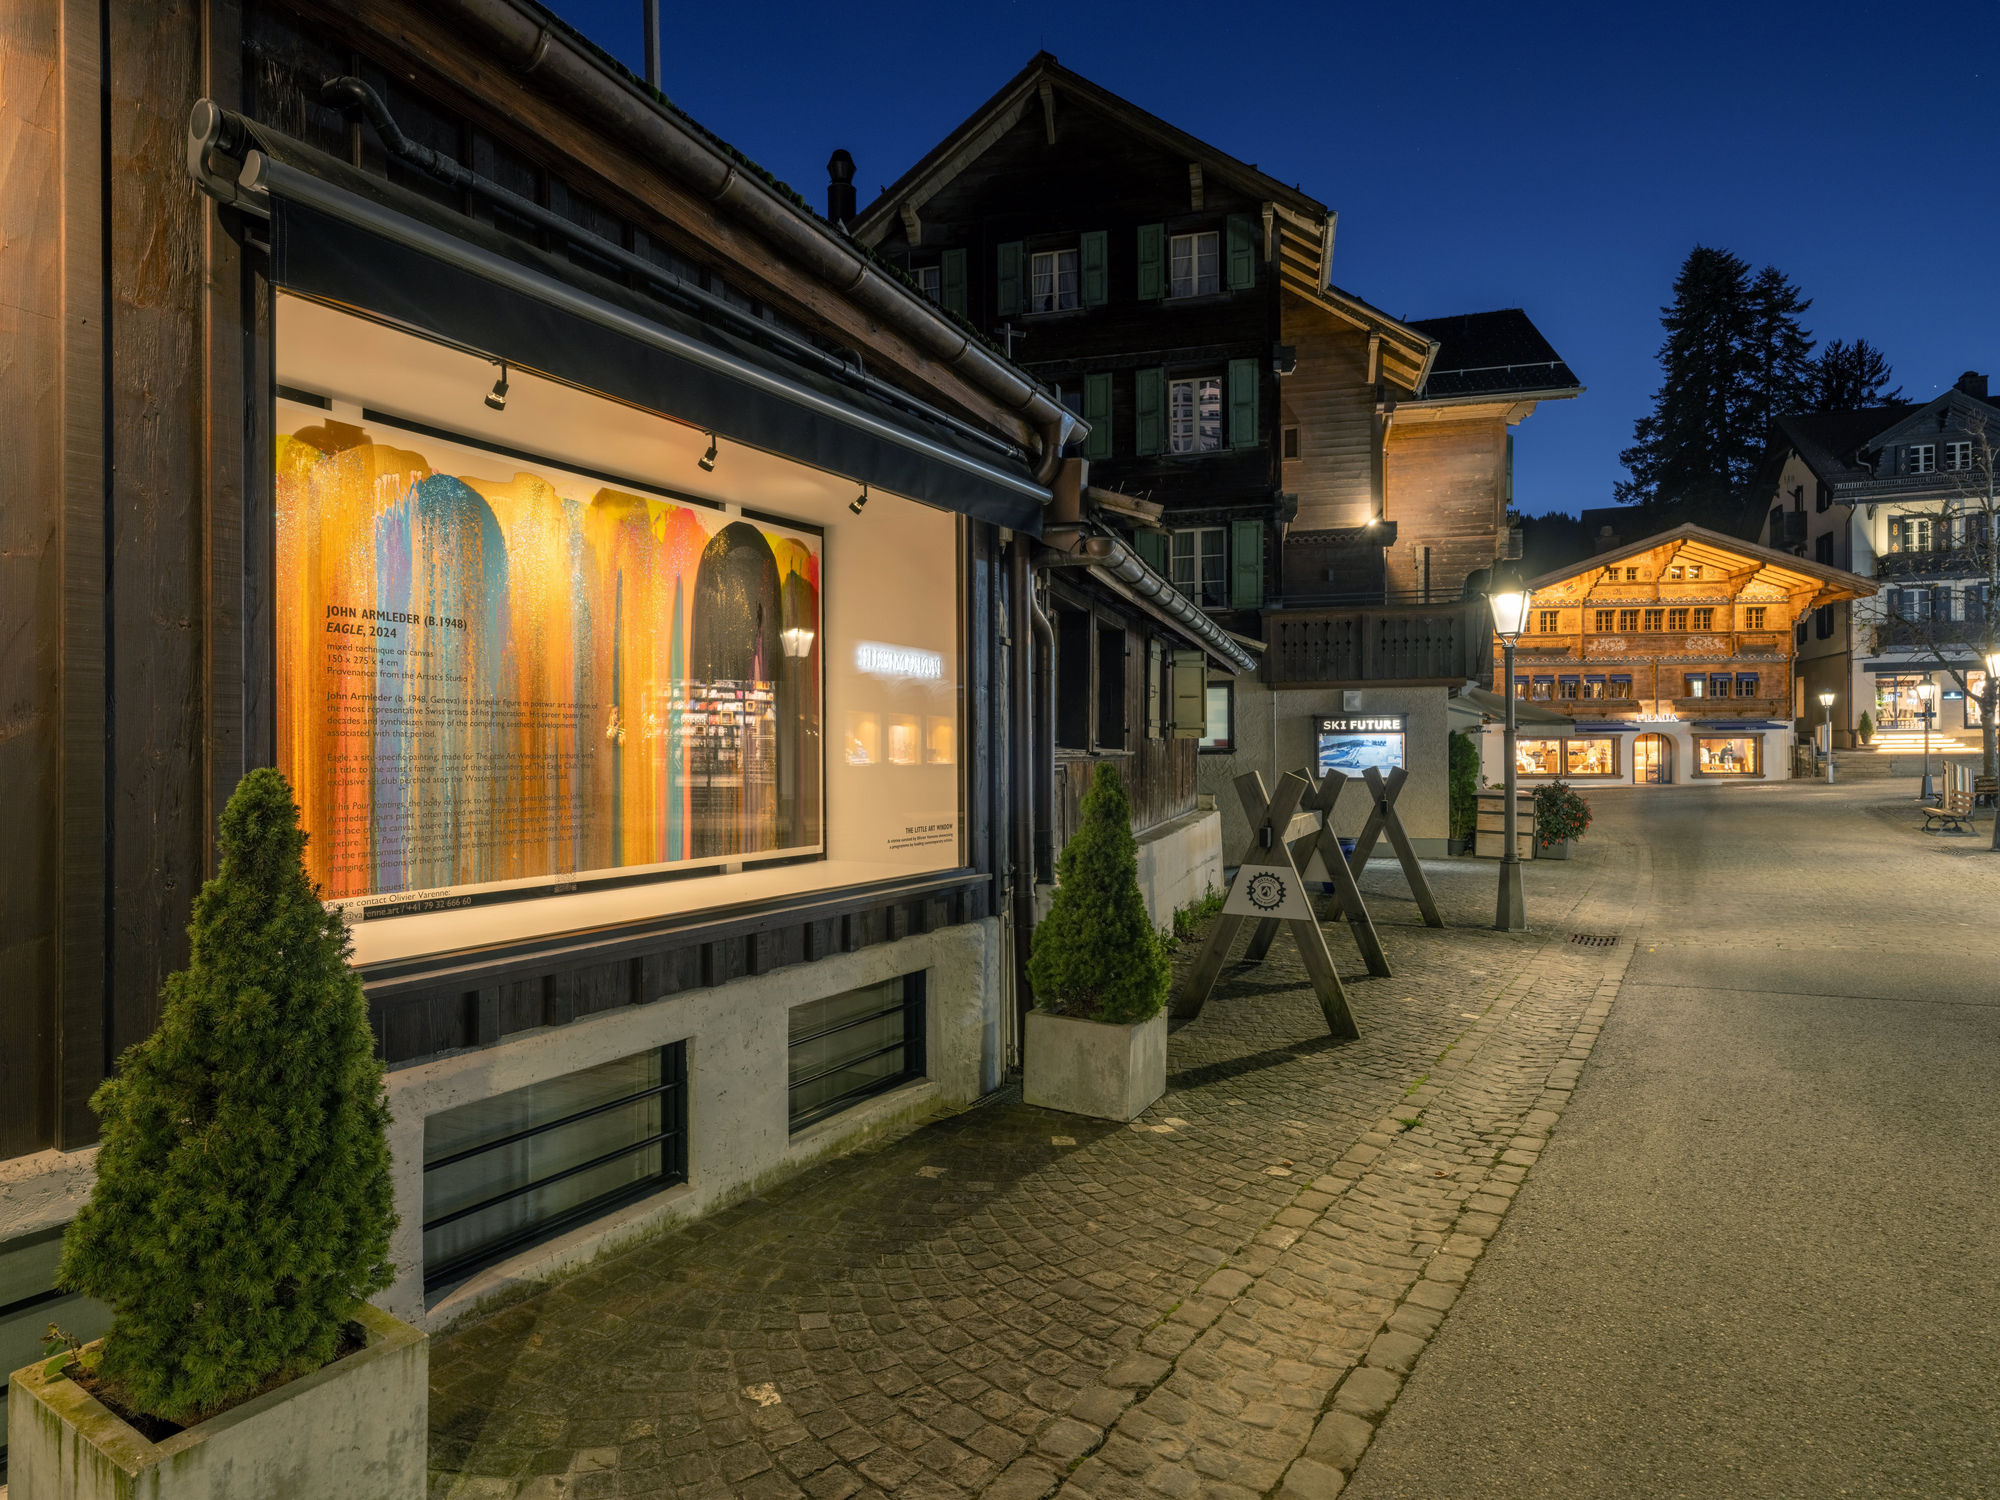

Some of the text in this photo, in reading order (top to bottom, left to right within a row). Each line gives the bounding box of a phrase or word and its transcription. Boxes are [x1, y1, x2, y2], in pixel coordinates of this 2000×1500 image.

[326, 606, 467, 632] JOHN ARMLEDER (B.1948)
[326, 622, 397, 638] EAGLE, 2024
[327, 644, 434, 658] mixed technique on canvas
[328, 654, 343, 663] 150
[354, 656, 369, 665] 275
[379, 658, 384, 666] 4
[327, 667, 468, 683] Provenance: from the Artist's Studio
[327, 692, 348, 701] John
[350, 692, 393, 702] Armleder
[395, 694, 406, 704] (b.
[408, 695, 428, 705] 1948,
[430, 696, 460, 706] Geneva)
[327, 705, 340, 713] the
[367, 706, 423, 716] representative
[426, 707, 445, 716] Swiss
[447, 708, 469, 717] artists
[471, 708, 480, 716] of
[1636, 713, 1680, 722] PRADA
[327, 716, 361, 725] decades
[363, 718, 378, 726] and
[380, 718, 423, 728] synthesizes
[426, 720, 444, 729] many
[447, 719, 454, 727] of
[456, 720, 468, 728] the
[1324, 720, 1401, 730] SKI FUTURE
[327, 728, 436, 740] associated with that period.
[328, 753, 351, 763] Eagle,
[409, 752, 440, 762] painting,
[442, 752, 461, 760] made
[463, 752, 474, 760] for
[340, 765, 356, 774] title
[386, 764, 412, 773] artist's
[414, 764, 436, 773] father
[462, 764, 469, 772] of
[382, 776, 397, 785] club
[400, 775, 430, 787] perched
[433, 776, 449, 785] atop
[452, 774, 463, 783] the
[338, 802, 350, 811] his
[352, 802, 369, 810] Pour
[409, 800, 421, 808] the
[424, 798, 441, 809] body
[454, 797, 471, 806] work
[328, 814, 369, 824] Armleder
[423, 810, 442, 819] often
[468, 808, 484, 816] with
[344, 826, 361, 835] face
[390, 824, 416, 833] canvas,
[419, 820, 442, 830] where
[382, 835, 399, 845] Pour
[434, 832, 453, 841] make
[342, 851, 355, 860] the
[409, 846, 416, 855] of
[418, 846, 431, 854] the
[328, 864, 364, 874] changing
[366, 860, 407, 870] conditions
[409, 856, 417, 866] of
[419, 856, 432, 865] the
[328, 888, 350, 896] Price
[352, 887, 373, 897] upon
[357, 896, 386, 905] contact
[389, 892, 416, 903] Olivier
[418, 890, 451, 900] Varenne:
[344, 907, 399, 922] @varenne.art
[407, 902, 421, 912] +41
[424, 901, 433, 910] 79
[436, 900, 444, 909] 32
[447, 898, 460, 907] 666
[462, 896, 472, 905] 60
